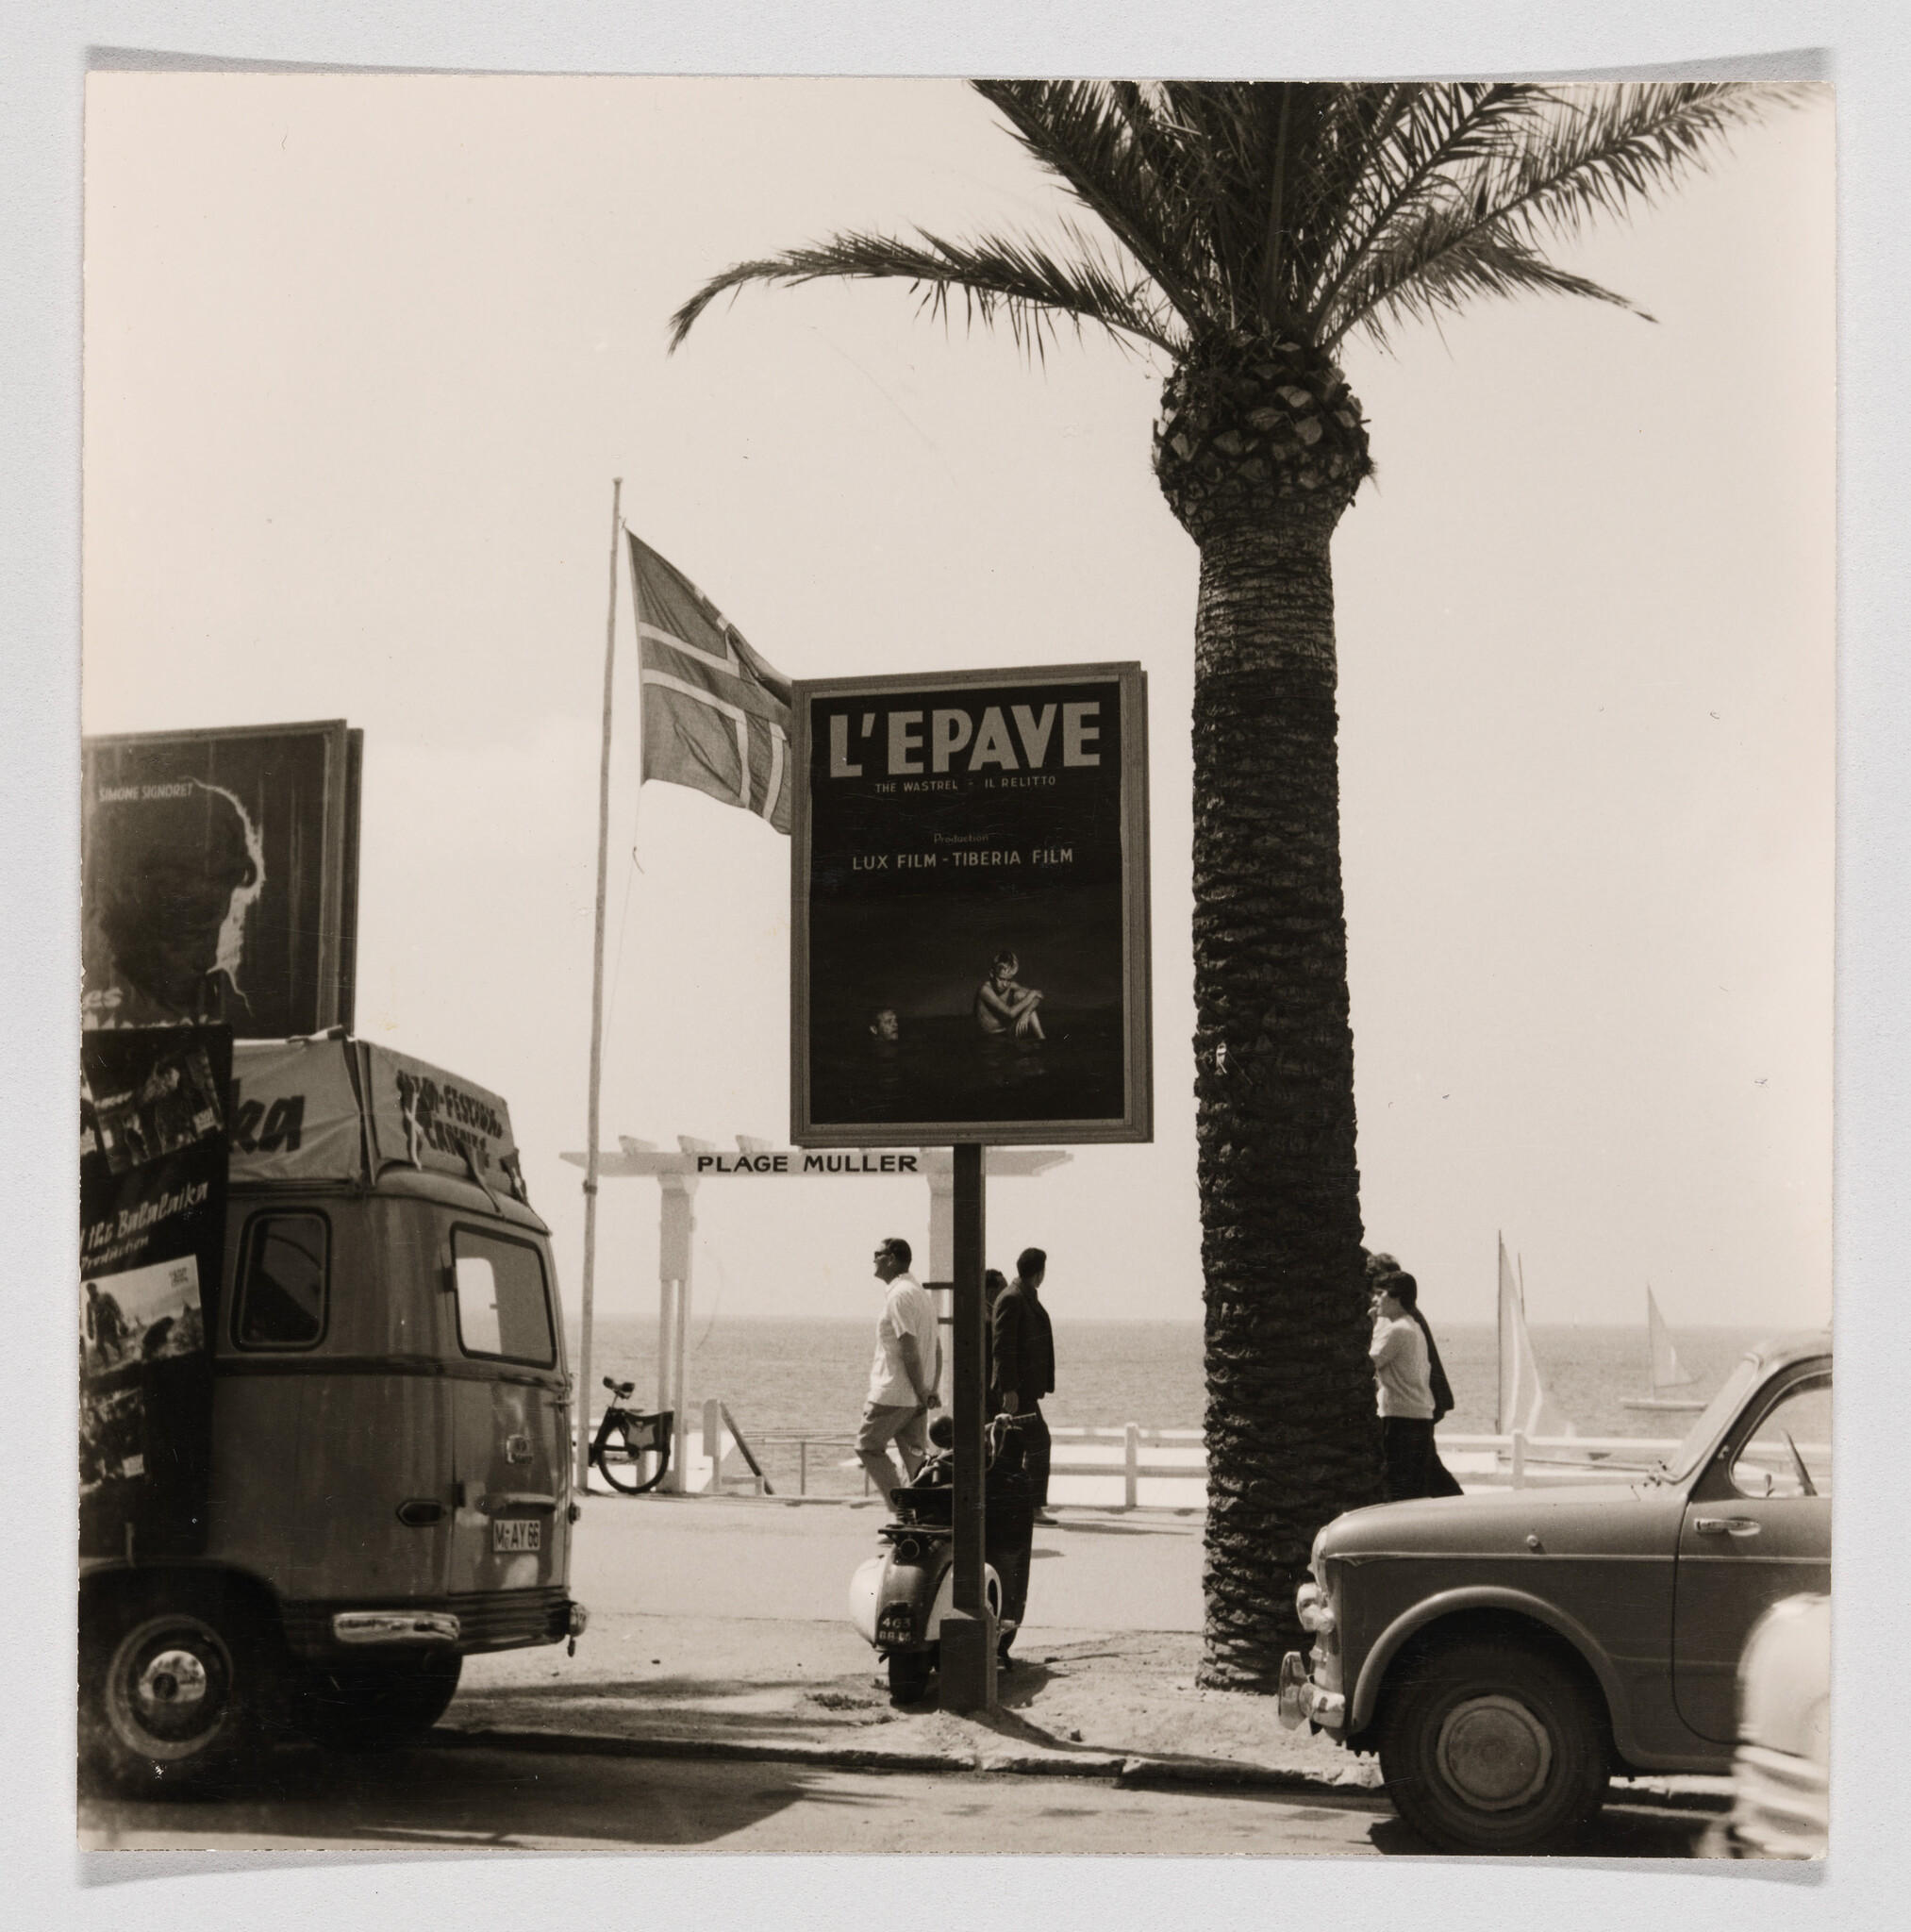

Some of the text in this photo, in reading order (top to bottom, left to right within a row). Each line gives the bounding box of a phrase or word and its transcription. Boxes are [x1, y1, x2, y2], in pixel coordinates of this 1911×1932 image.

[830, 702, 1101, 778] L'EPAVE
[99, 782, 192, 802] SIMONE SIGNORET
[875, 783, 897, 793] THE
[904, 779, 958, 791] WASTREL
[985, 778, 995, 789] IL
[1002, 775, 1056, 788] RELITTO
[934, 833, 989, 843] Production
[853, 855, 889, 871] LUX
[897, 853, 937, 868] FILM
[953, 850, 1022, 866] TIBERIA
[1032, 848, 1073, 864] FILM
[697, 1155, 918, 1173] PLAGE MULLER
